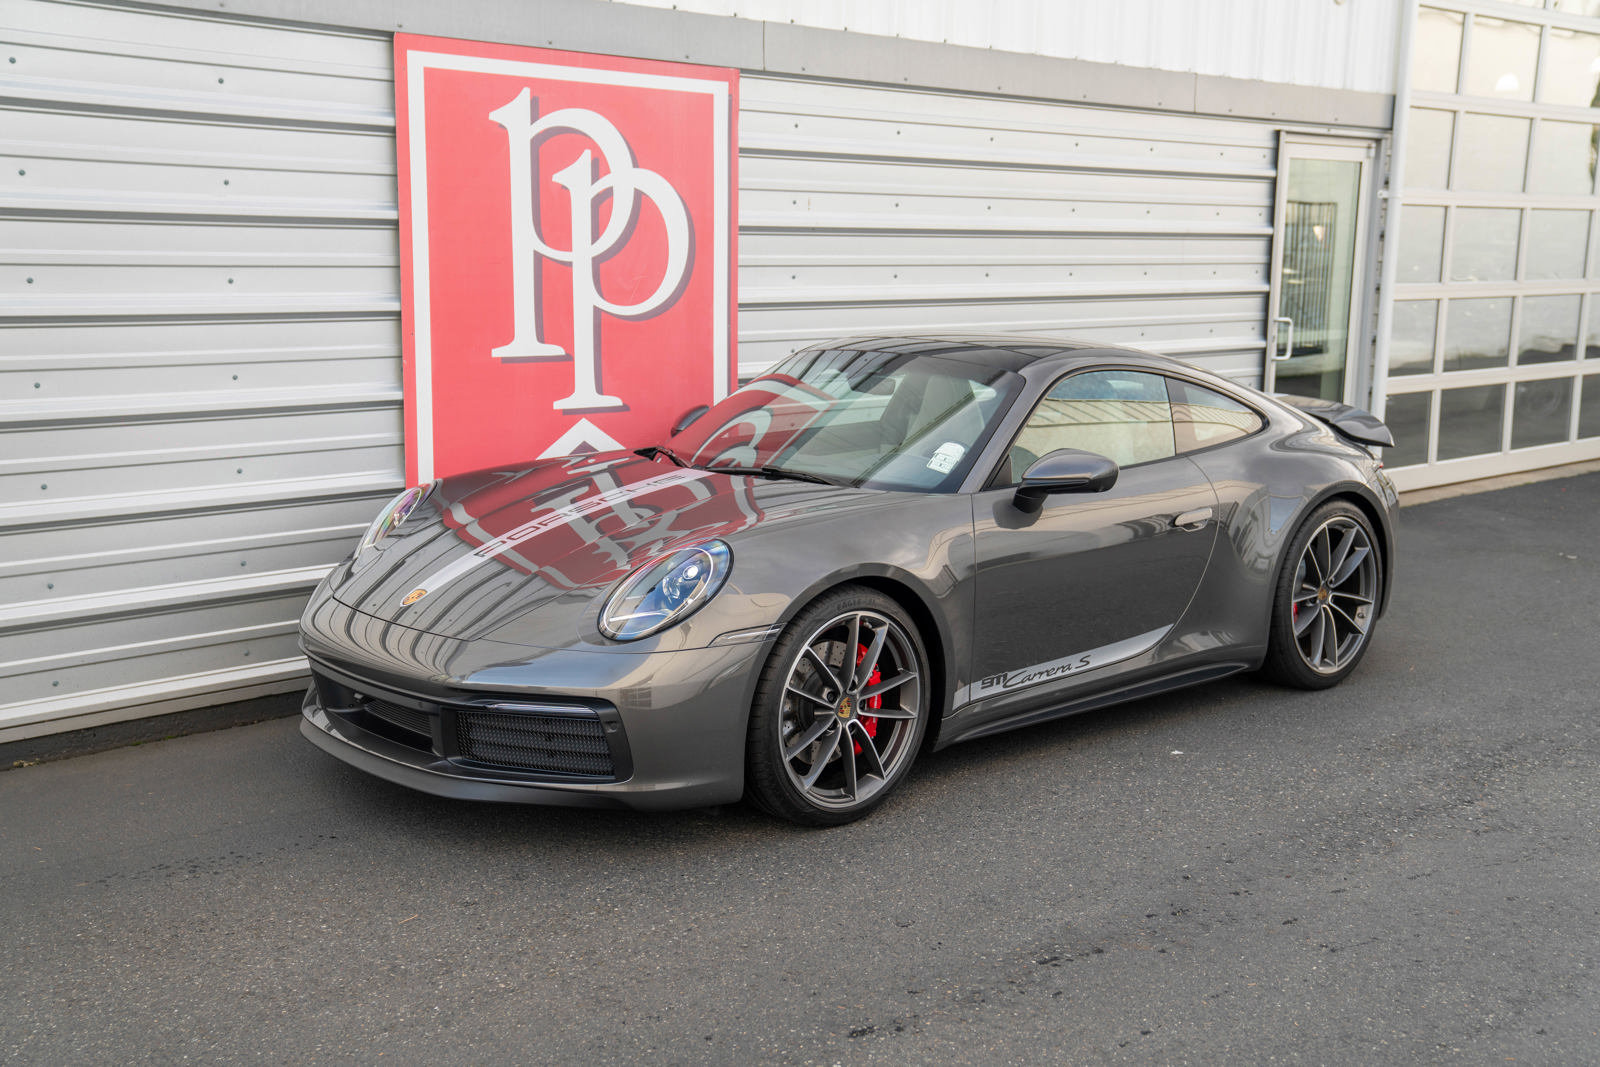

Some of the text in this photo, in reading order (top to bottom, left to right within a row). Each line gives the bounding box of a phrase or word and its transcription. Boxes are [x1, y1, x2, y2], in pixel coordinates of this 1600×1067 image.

[474, 474, 686, 557] PORSCHE
[980, 654, 1092, 690] 911 Carrera S
